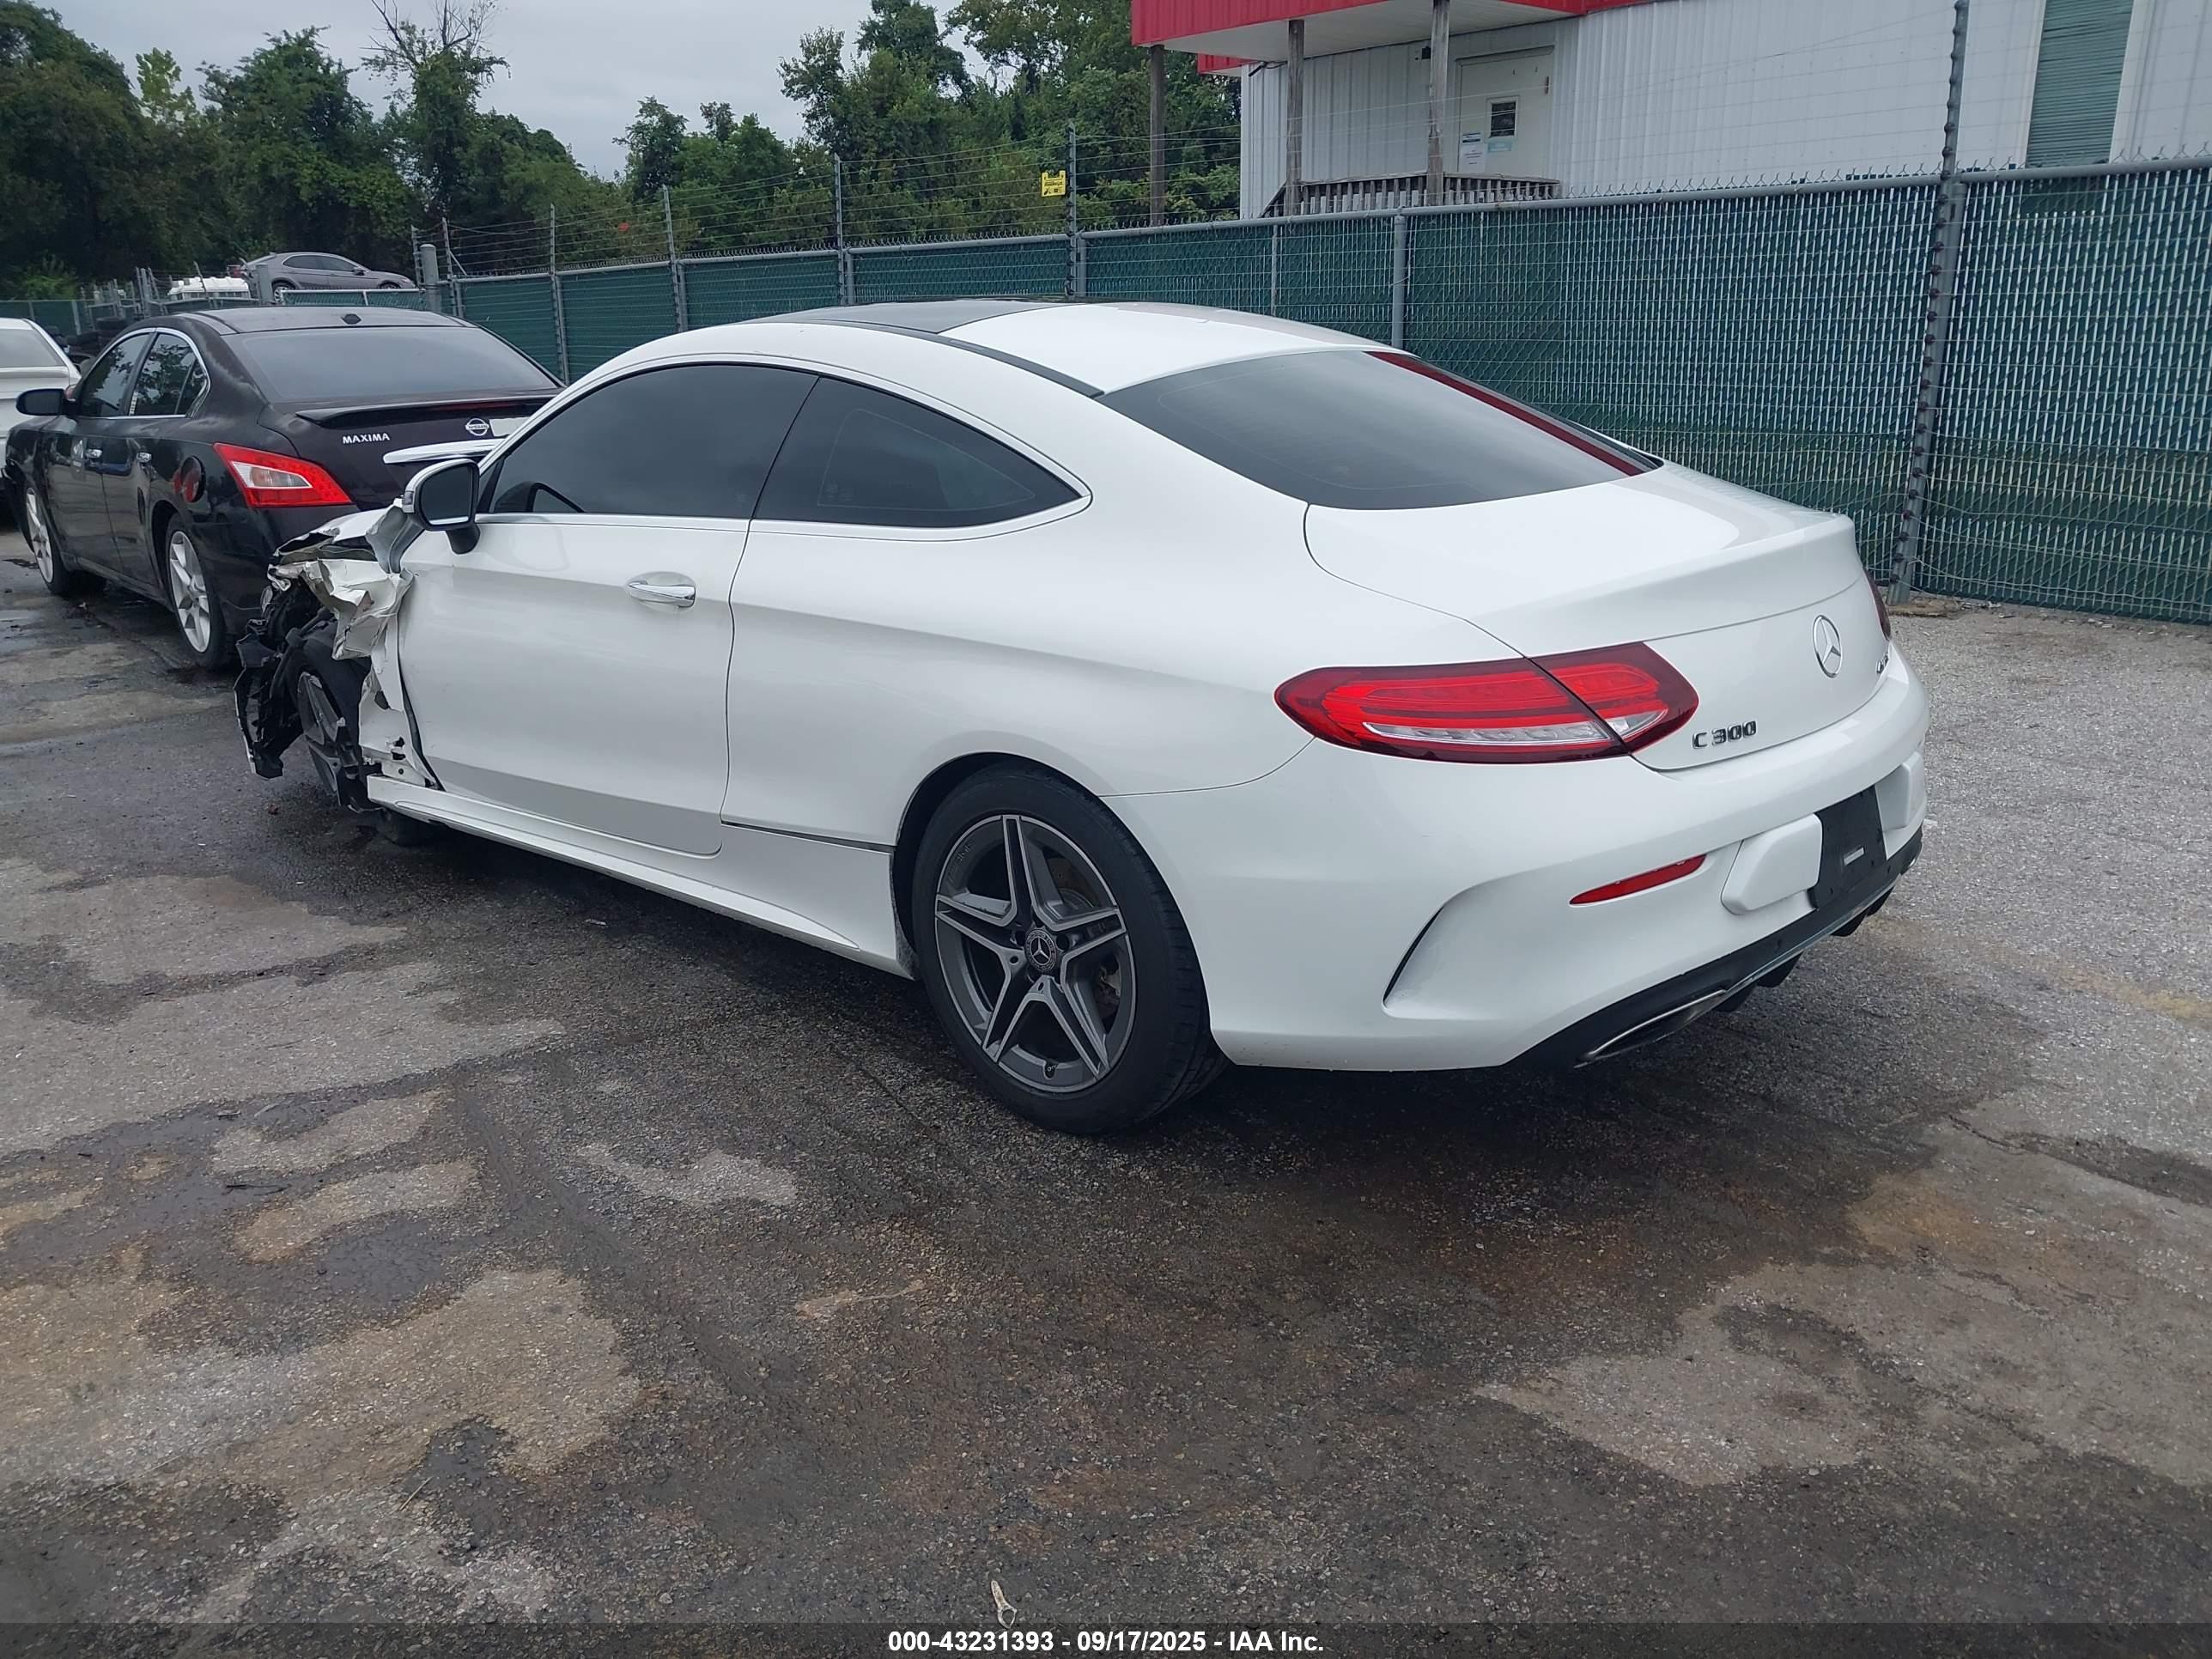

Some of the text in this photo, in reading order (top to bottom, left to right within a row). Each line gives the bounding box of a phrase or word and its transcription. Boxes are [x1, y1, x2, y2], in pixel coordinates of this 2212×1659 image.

[343, 433, 390, 444] MAXIMA
[1692, 720, 1757, 749] C 300
